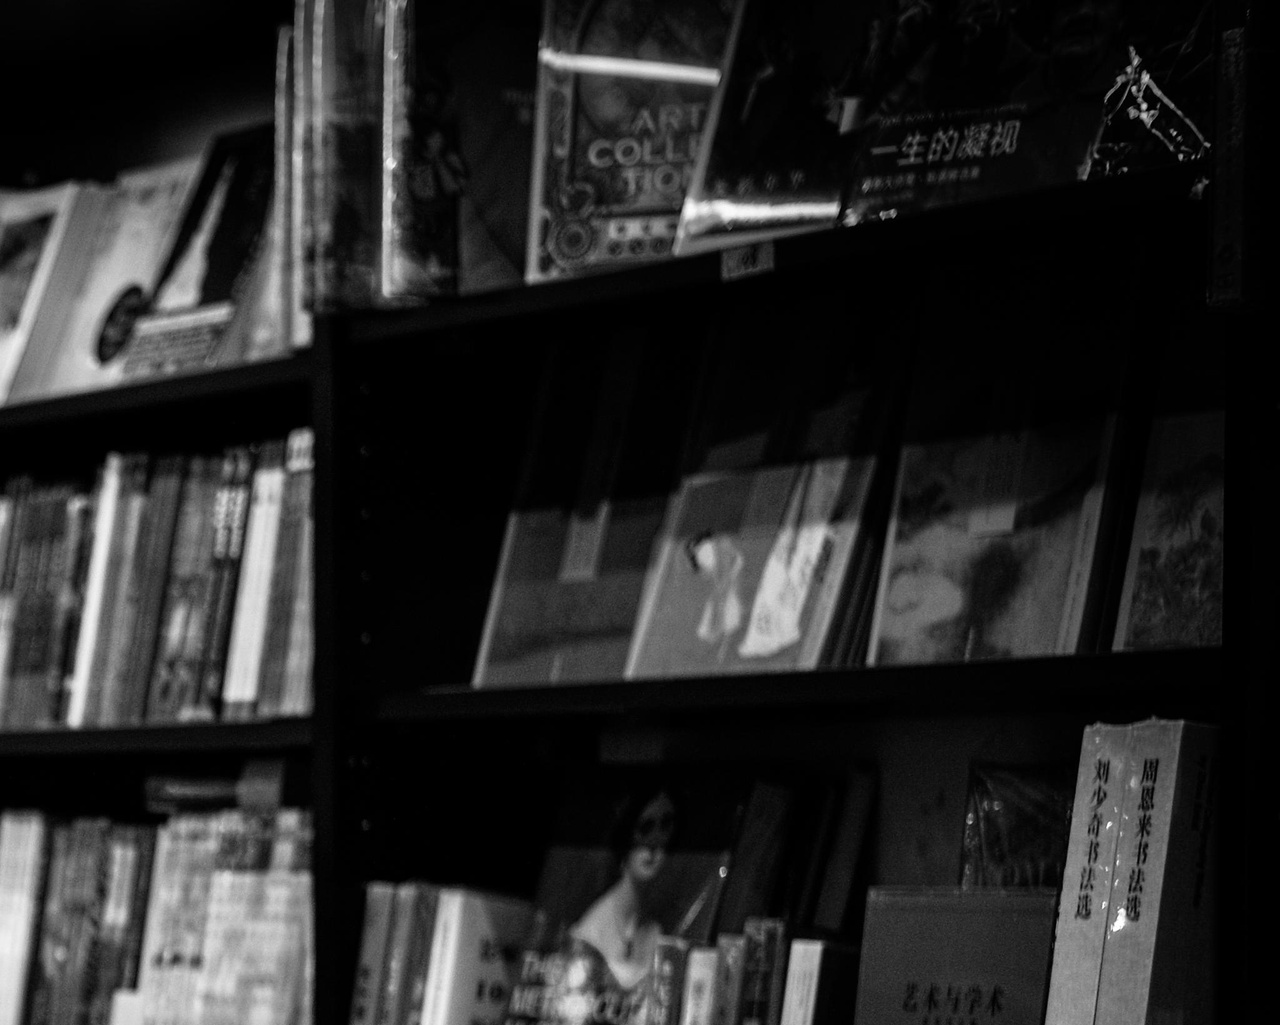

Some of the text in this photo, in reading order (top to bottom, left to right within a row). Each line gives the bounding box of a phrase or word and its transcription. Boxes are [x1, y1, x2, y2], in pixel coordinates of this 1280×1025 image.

[630, 102, 706, 135] ART
[870, 119, 1021, 167] 一生的凝视
[1074, 758, 1111, 921] 刘少奇书法选
[1126, 758, 1160, 922] 周恩来书法选
[902, 982, 1004, 1017] 艺术与学术
